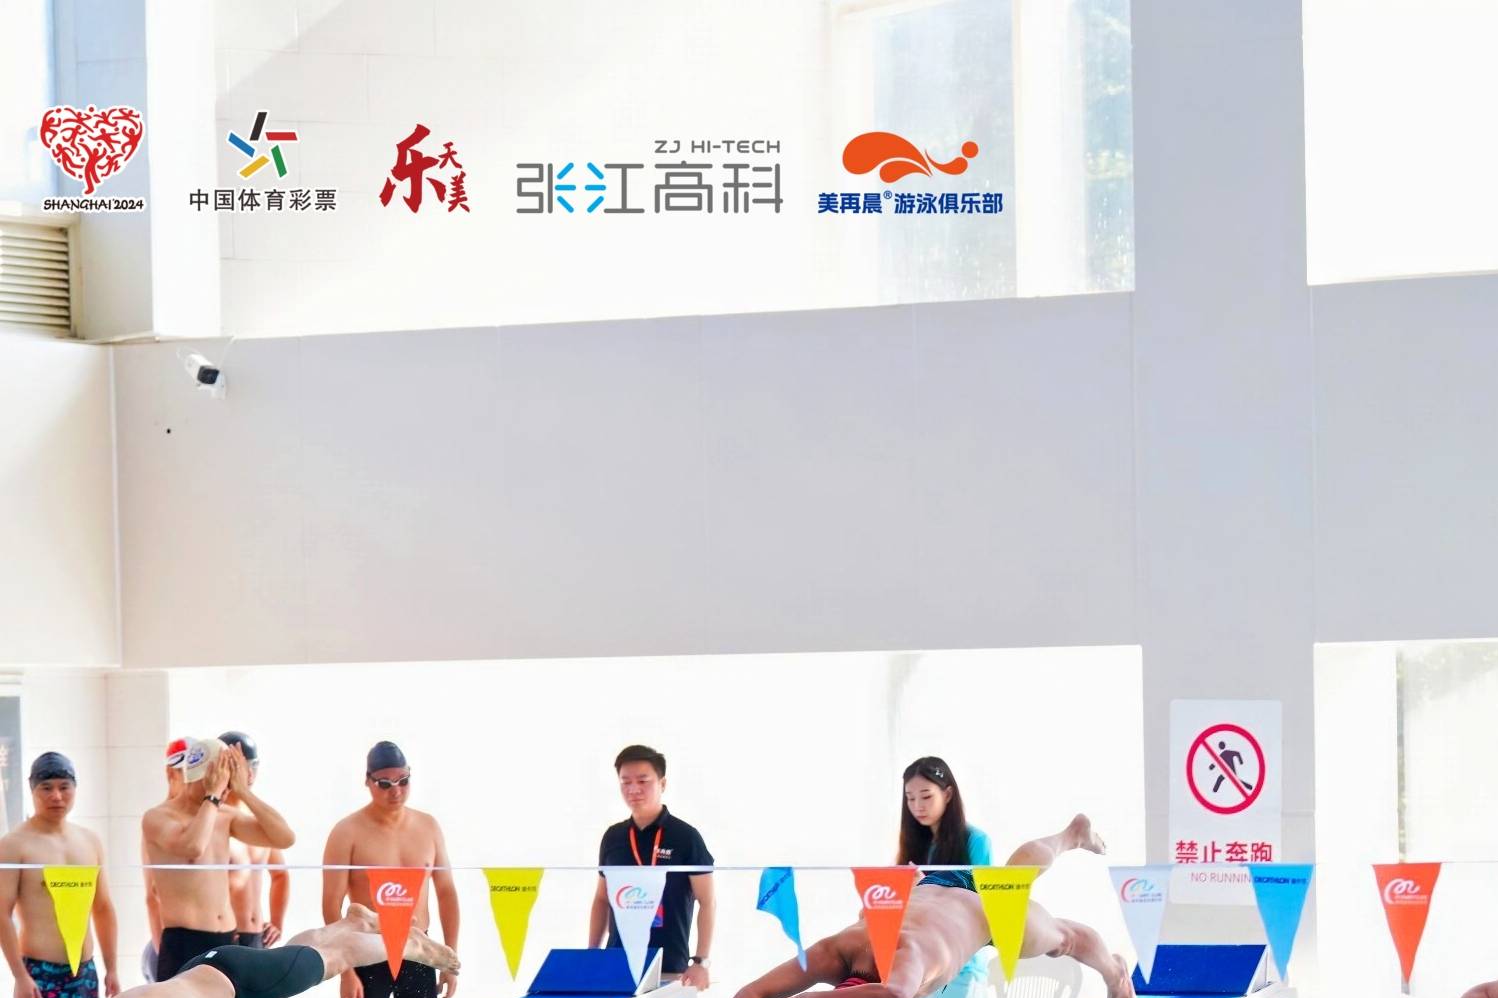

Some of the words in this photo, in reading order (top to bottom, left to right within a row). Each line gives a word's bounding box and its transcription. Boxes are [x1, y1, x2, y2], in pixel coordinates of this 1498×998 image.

[1175, 840, 1273, 864] 禁止奔跑
[1190, 872, 1208, 883] NO
[1210, 872, 1251, 884] RUNNIN
